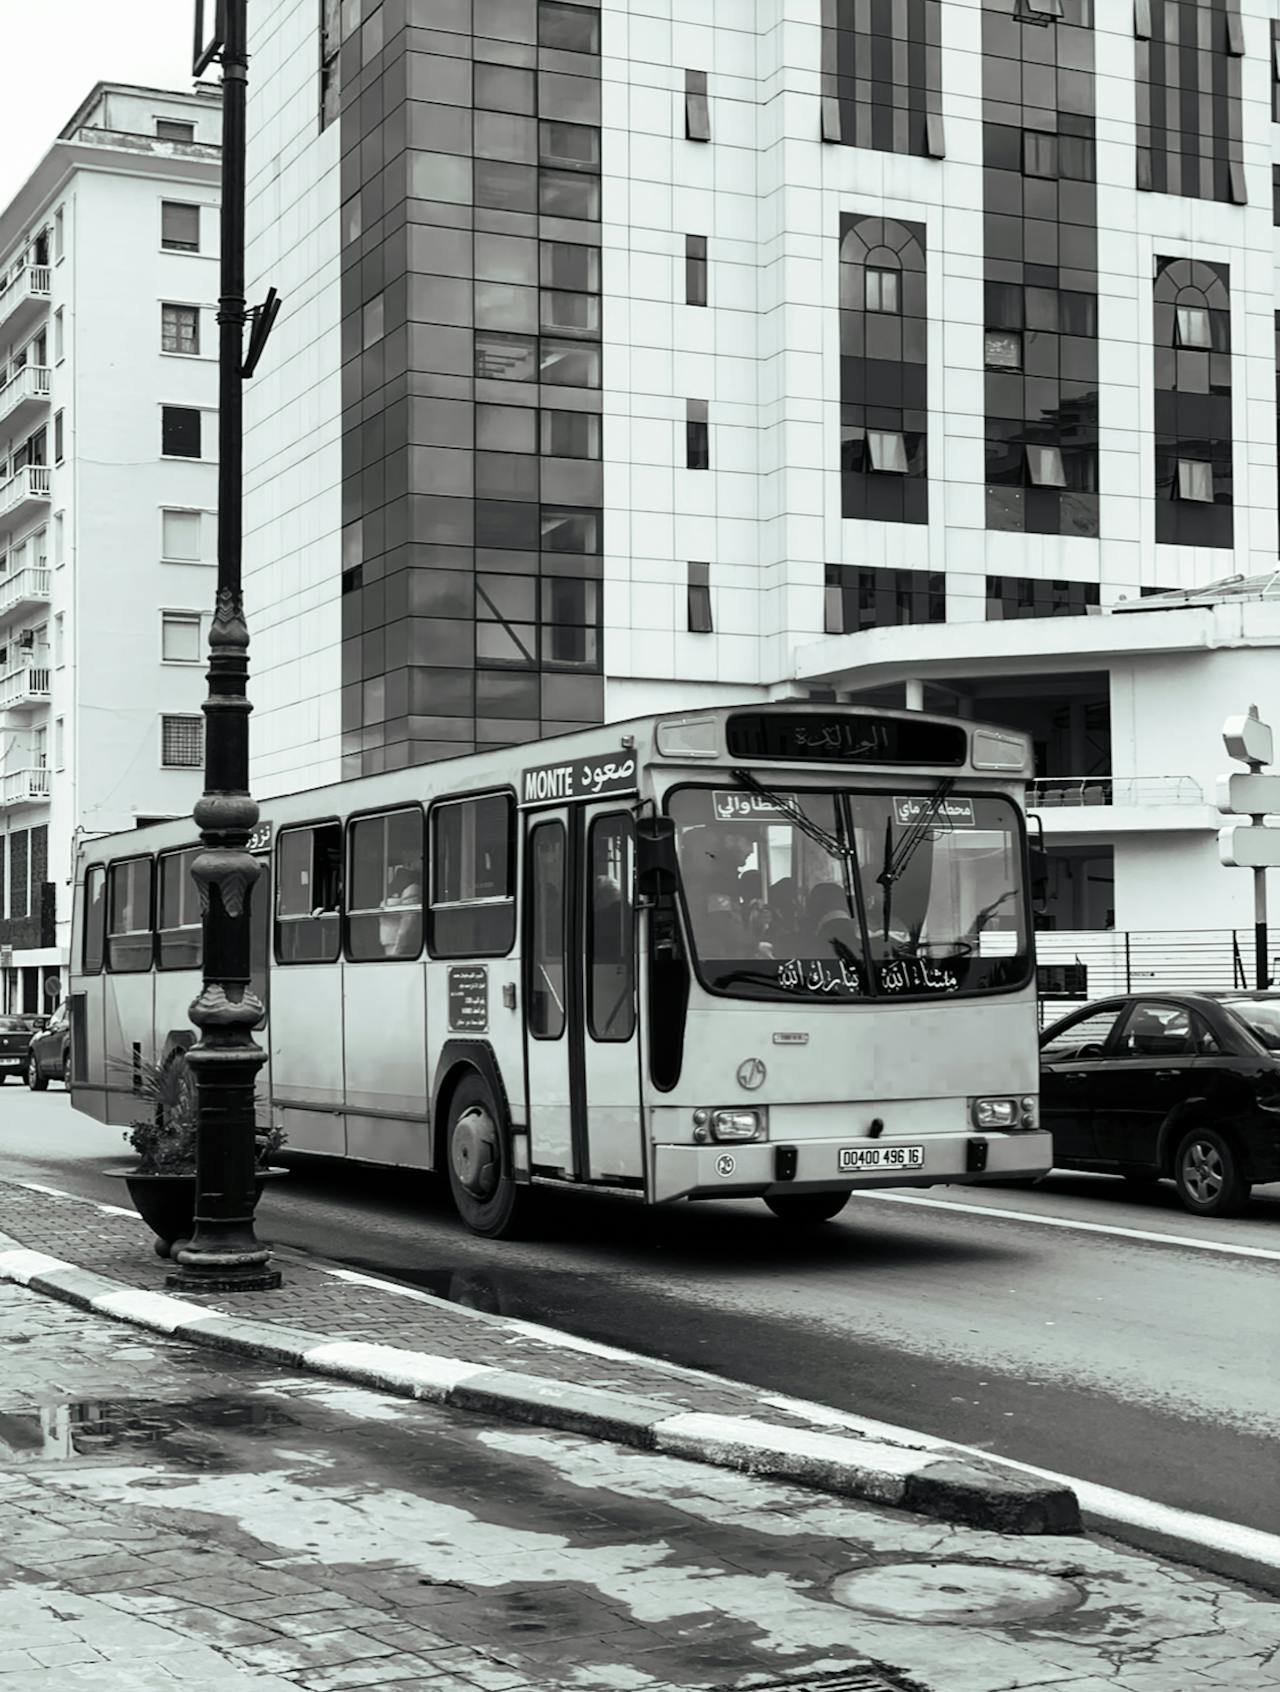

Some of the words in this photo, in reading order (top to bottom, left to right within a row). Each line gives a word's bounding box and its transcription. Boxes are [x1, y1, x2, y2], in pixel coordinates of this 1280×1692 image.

[525, 766, 574, 801] MONTE
[581, 759, 635, 792] صعود
[843, 1150, 880, 1166] 00400
[883, 1149, 905, 1164] 496
[908, 1149, 919, 1163] 16
